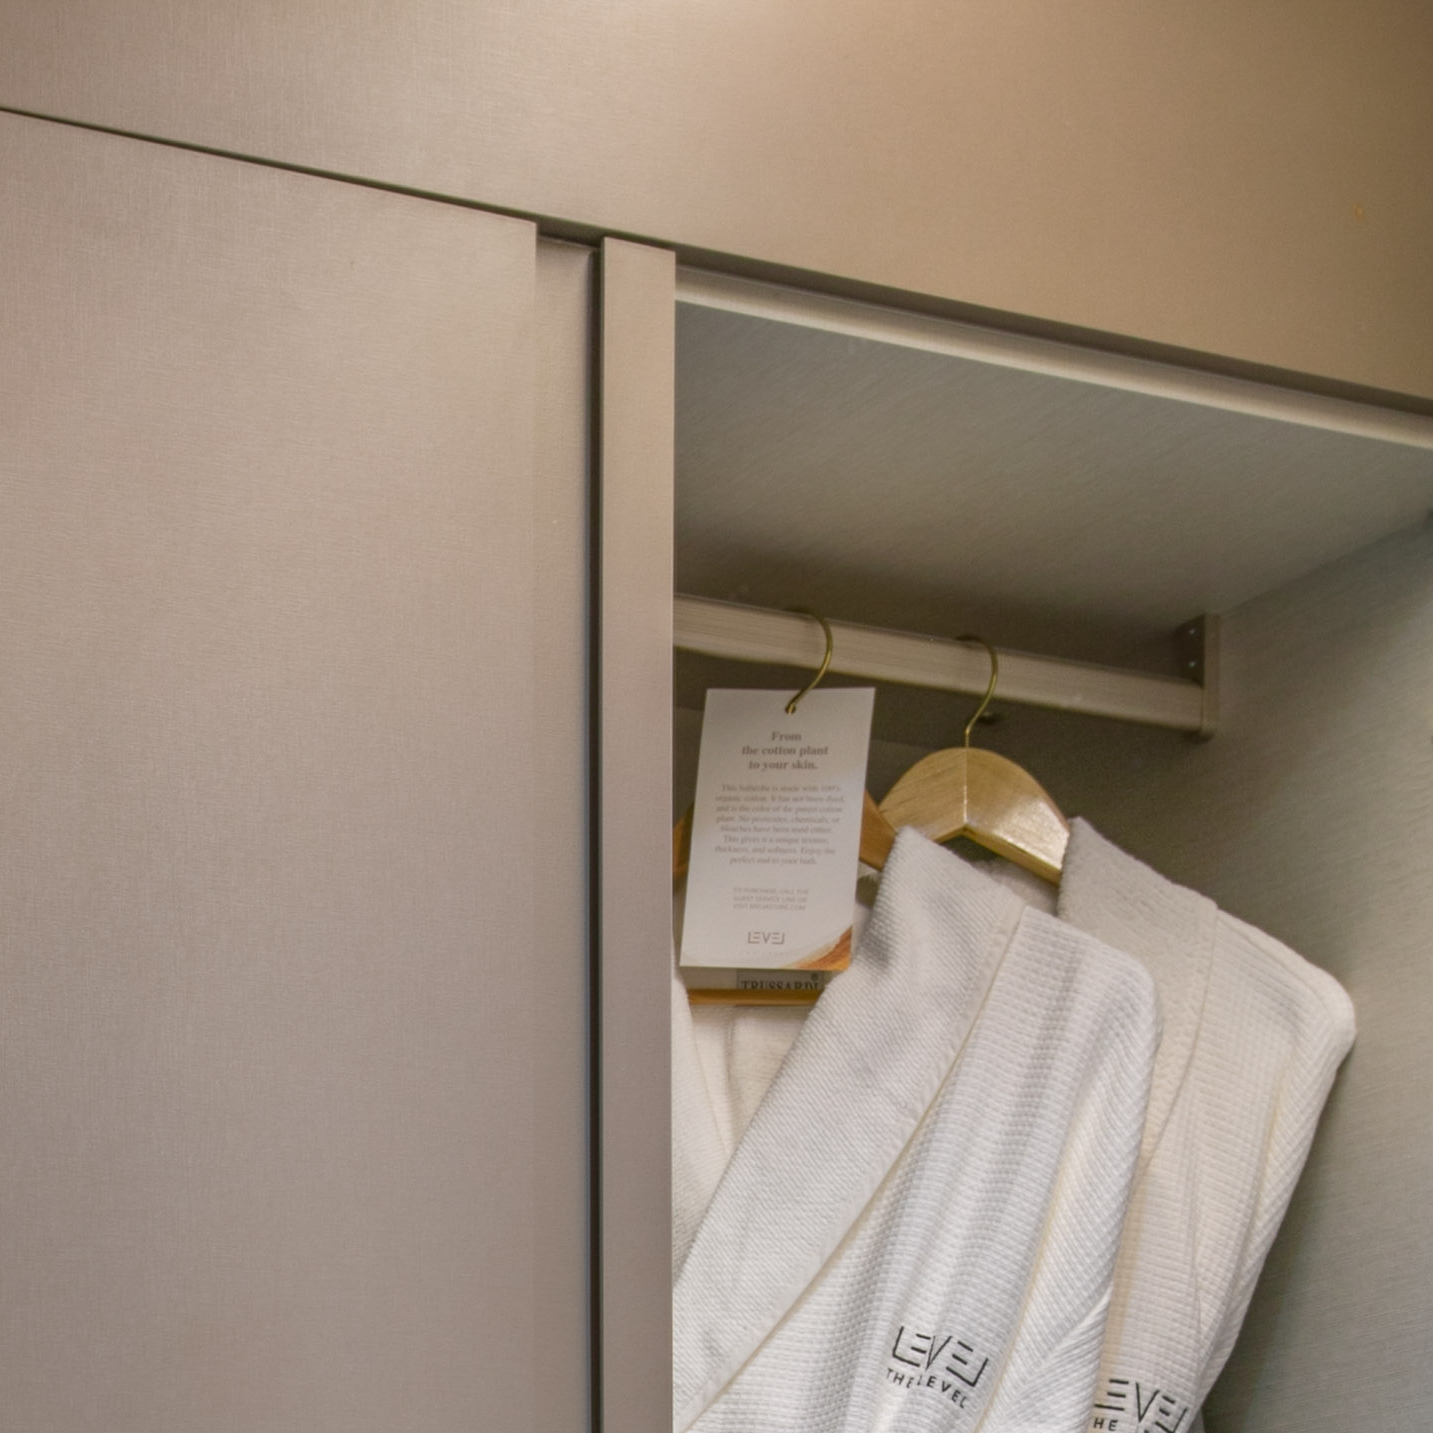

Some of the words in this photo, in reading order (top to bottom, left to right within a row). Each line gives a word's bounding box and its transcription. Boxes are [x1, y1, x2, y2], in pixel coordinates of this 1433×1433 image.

[772, 731, 802, 741] From
[742, 745, 759, 755] the
[761, 745, 796, 755] cotton
[799, 745, 828, 757] plant
[749, 760, 760, 769] to
[761, 762, 789, 772] your
[791, 760, 818, 769] skin.
[742, 980, 819, 990] TRUSSARDI
[892, 1326, 989, 1387] LEVEL
[886, 1368, 914, 1390] THE
[1093, 1417, 1118, 1432] HE
